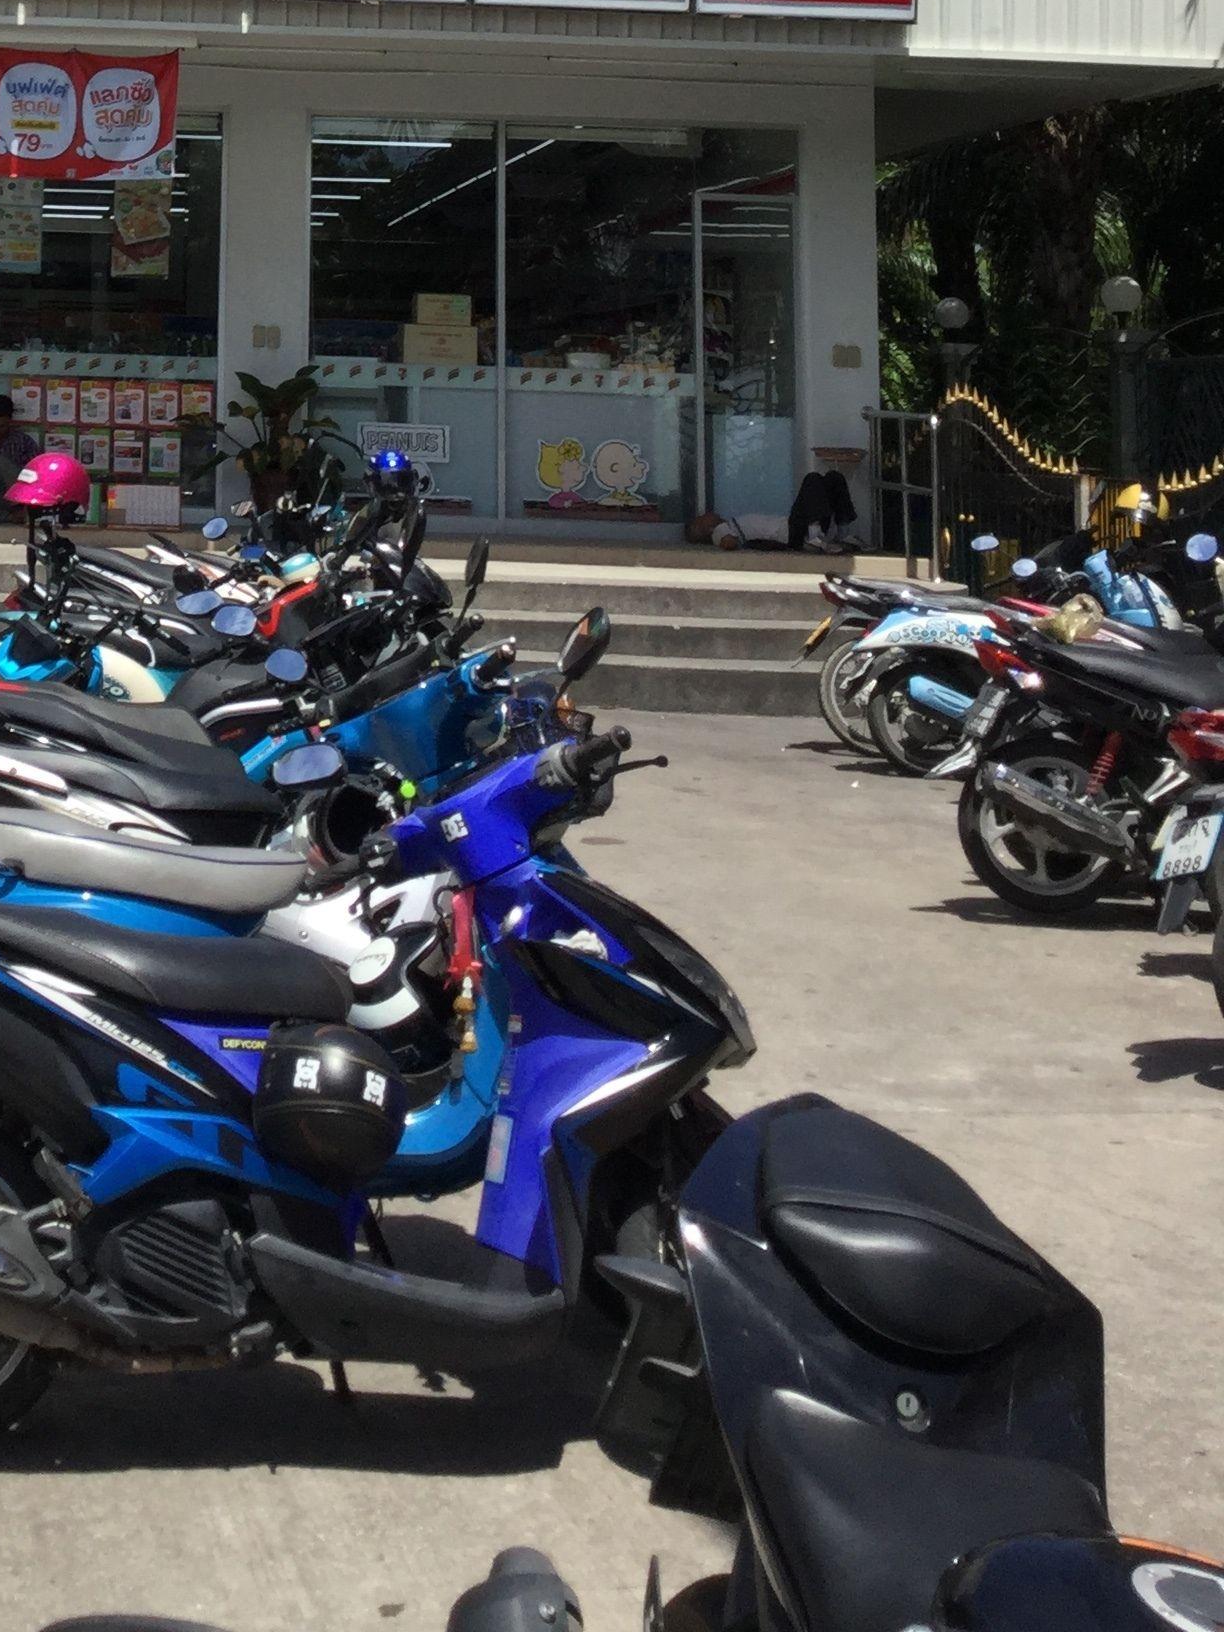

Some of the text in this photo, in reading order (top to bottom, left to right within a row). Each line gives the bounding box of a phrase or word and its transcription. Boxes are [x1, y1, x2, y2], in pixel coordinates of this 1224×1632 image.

[95, 104, 153, 133] สุดคุ้ม
[13, 132, 41, 153] 79
[366, 430, 440, 453] PEANUTS
[1162, 855, 1203, 877] 8898
